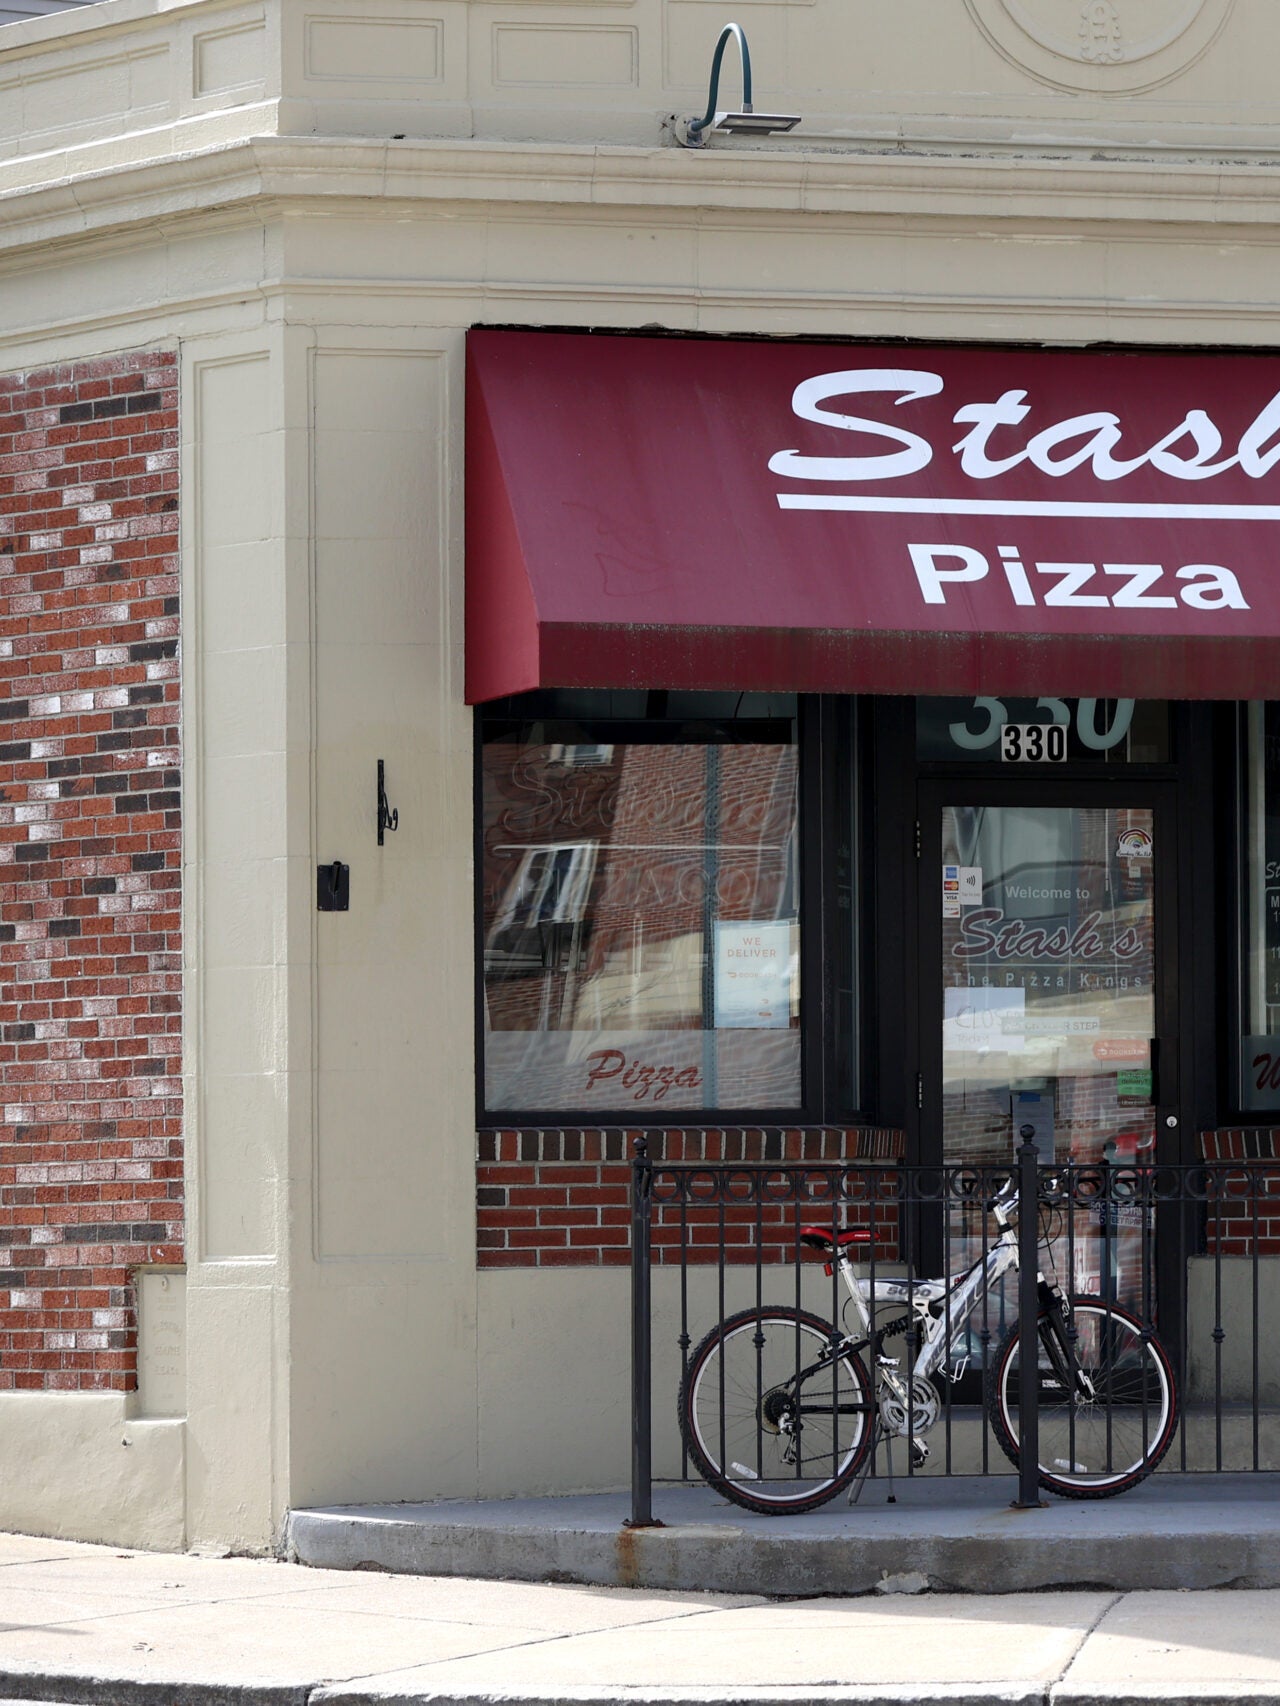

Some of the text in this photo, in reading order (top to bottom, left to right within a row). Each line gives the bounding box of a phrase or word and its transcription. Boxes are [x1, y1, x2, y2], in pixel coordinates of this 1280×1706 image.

[907, 543, 1250, 610] Pizza
[1004, 725, 1065, 761] 330
[1004, 885, 1090, 900] Welcome to
[742, 936, 761, 946] WE
[952, 907, 1143, 959] Stashs
[727, 948, 777, 958] DELIVER
[953, 972, 1143, 990] The Pizza Kings
[1073, 1021, 1098, 1031] STEP
[585, 1048, 704, 1100] Pizza
